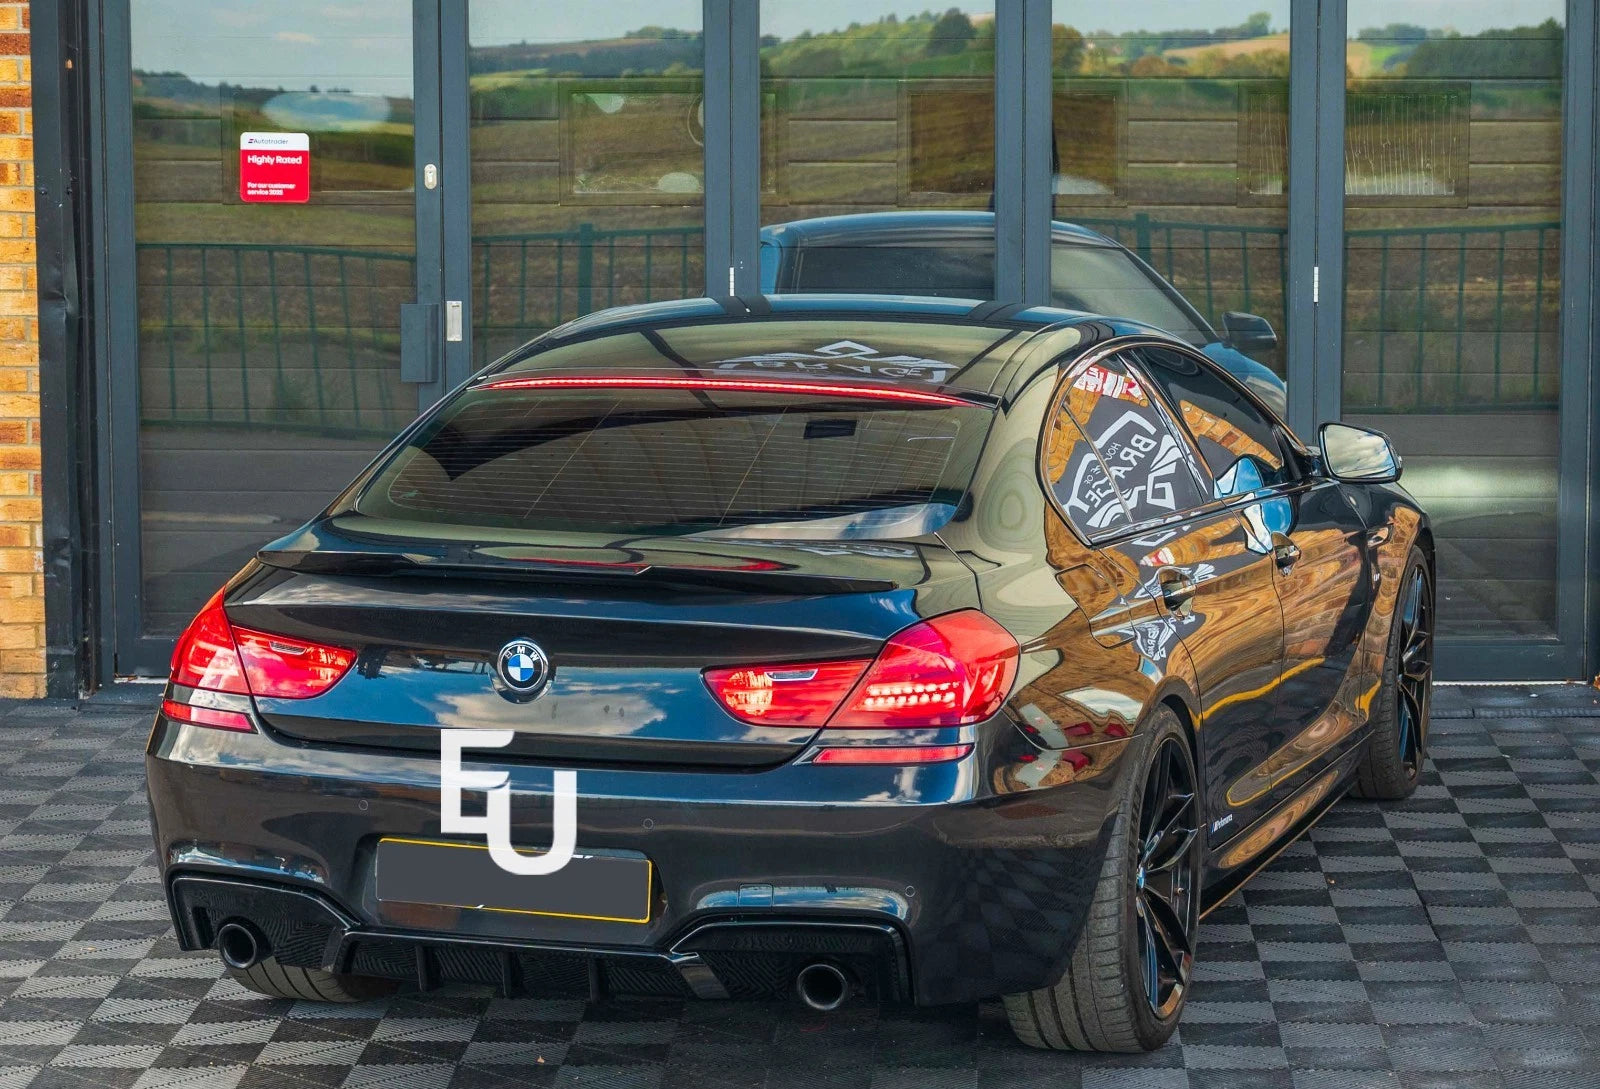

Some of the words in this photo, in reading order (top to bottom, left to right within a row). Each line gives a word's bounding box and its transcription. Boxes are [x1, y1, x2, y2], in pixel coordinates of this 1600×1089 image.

[247, 154, 275, 165] Highly
[275, 155, 303, 165] Rated
[504, 645, 540, 661] BMW
